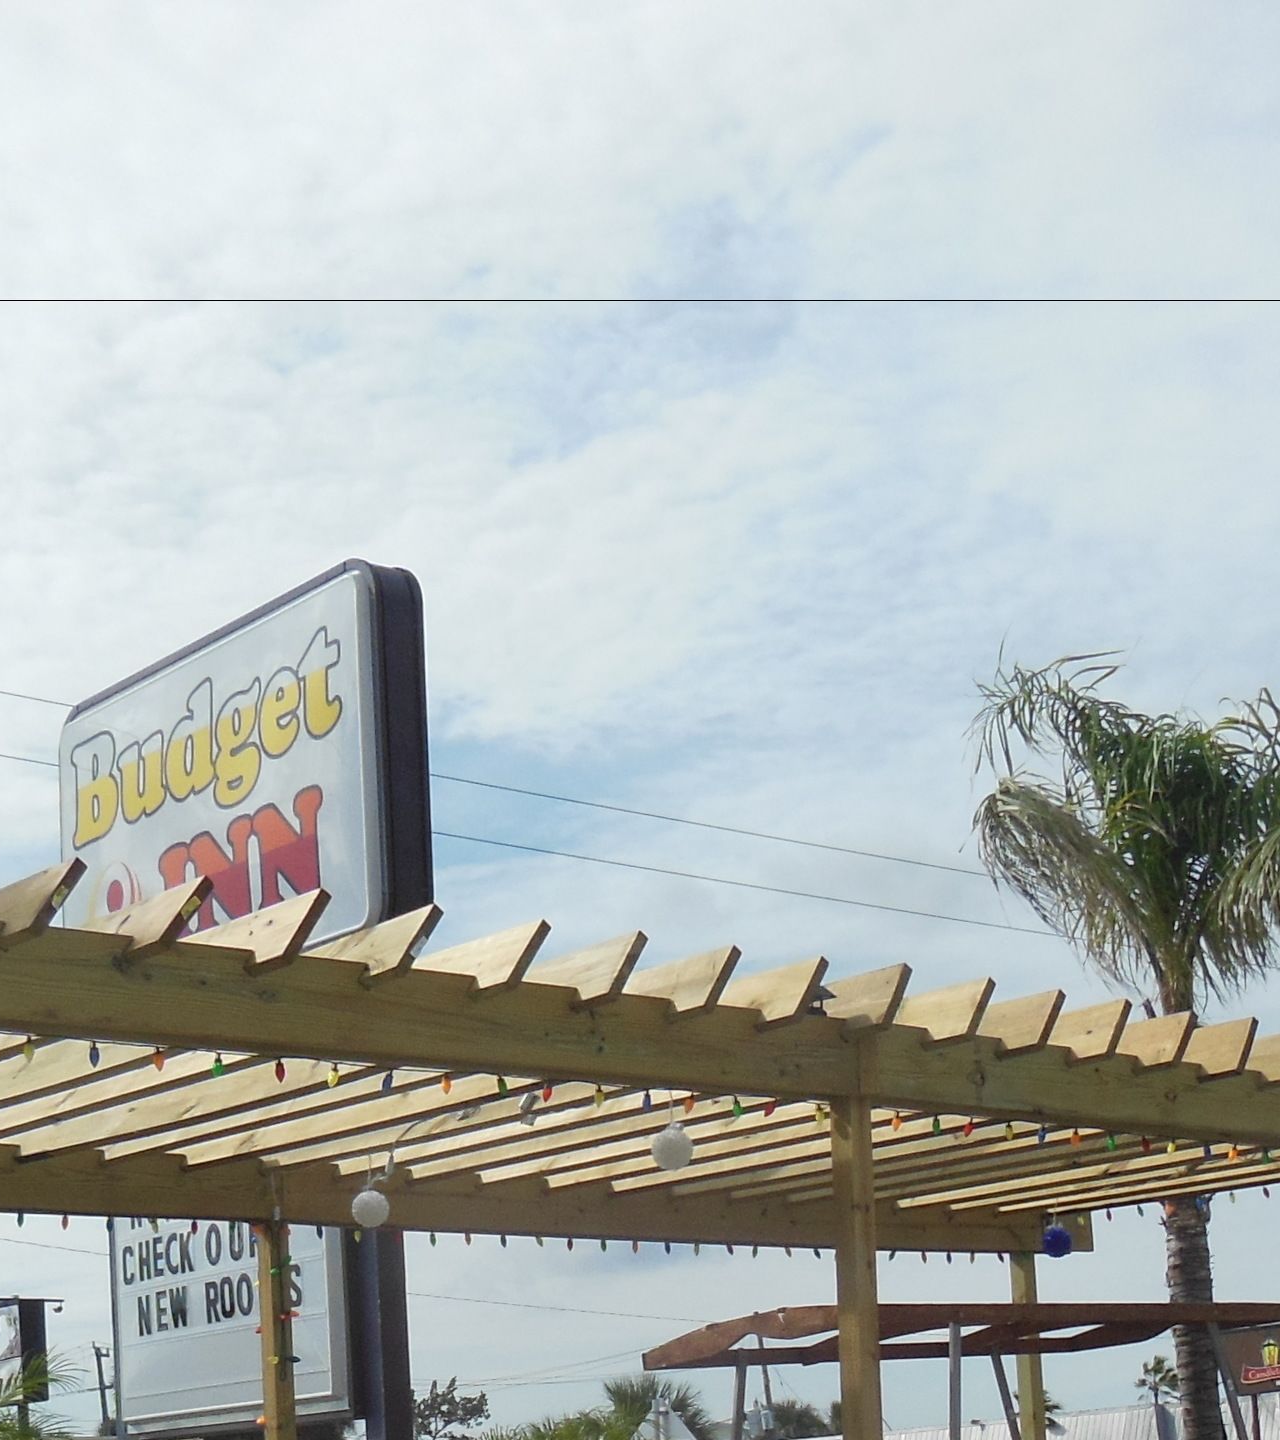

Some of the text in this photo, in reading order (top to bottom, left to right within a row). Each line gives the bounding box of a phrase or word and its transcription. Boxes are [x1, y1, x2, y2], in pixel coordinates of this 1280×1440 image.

[71, 625, 343, 850] Budget
[122, 1230, 195, 1286] CHECK
[137, 1263, 302, 1337] NEW ROOS
